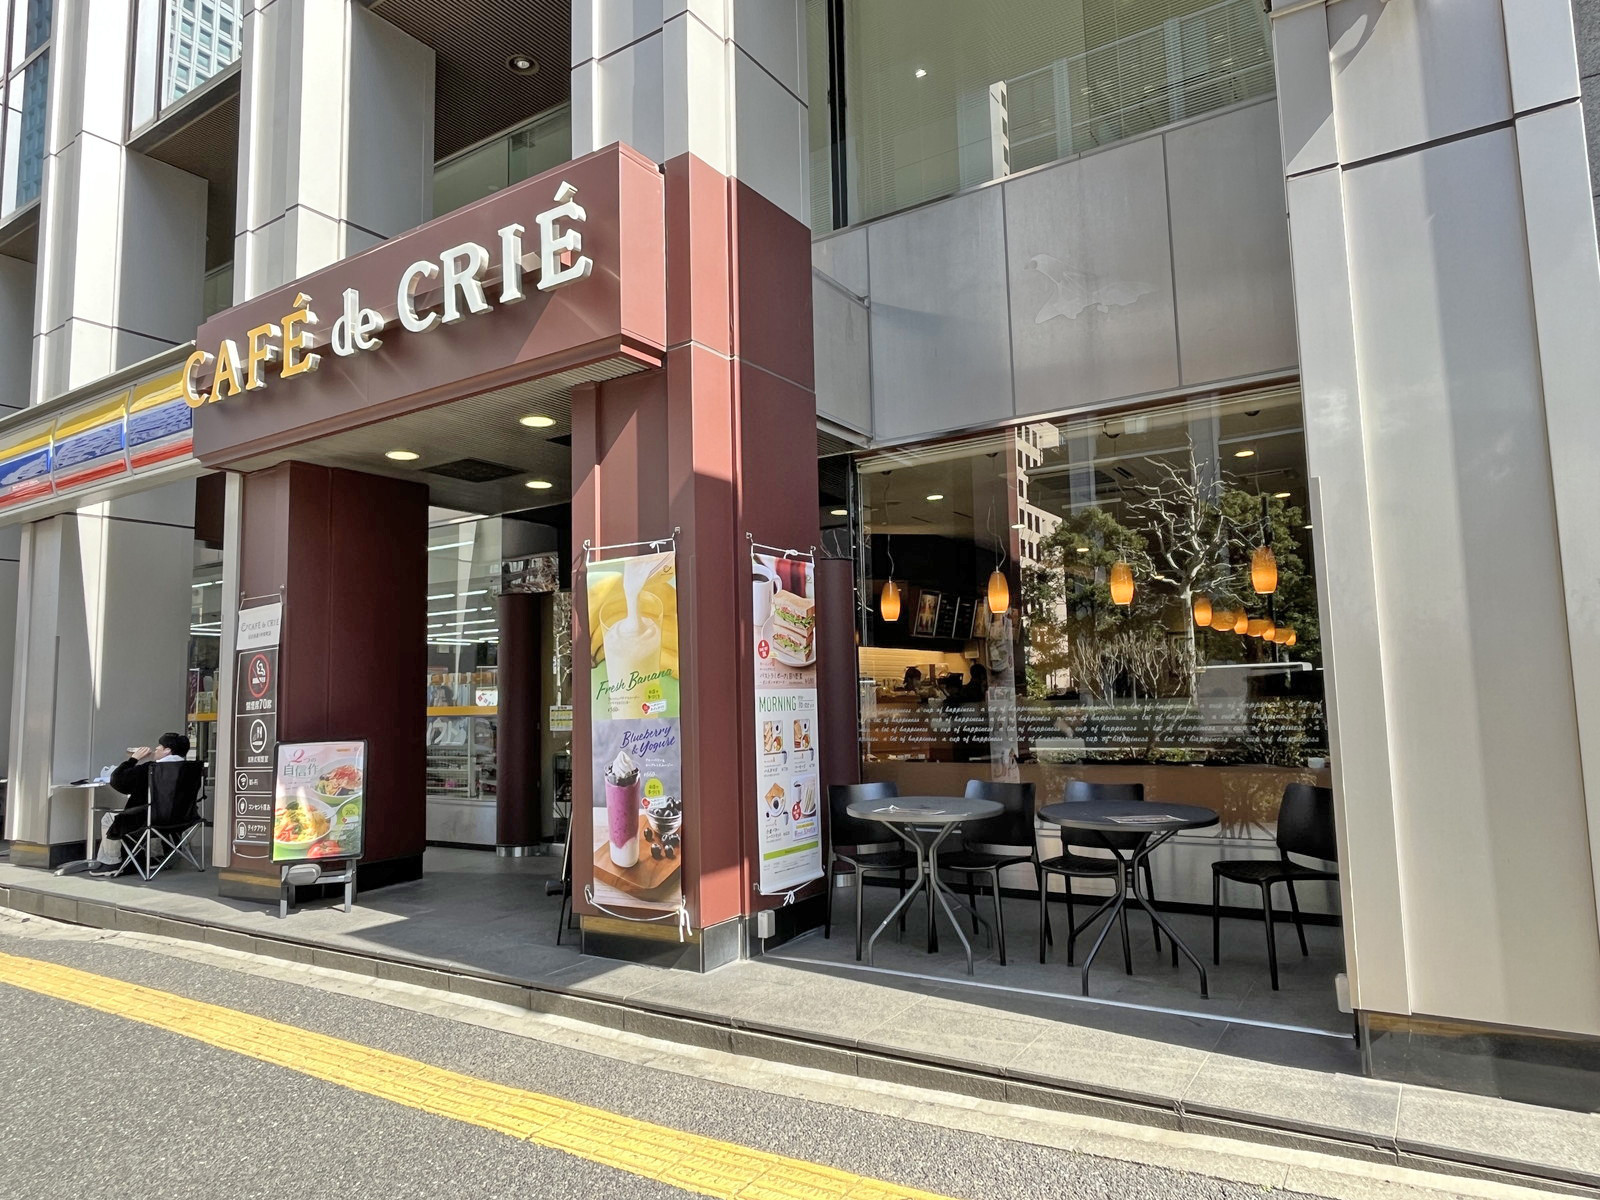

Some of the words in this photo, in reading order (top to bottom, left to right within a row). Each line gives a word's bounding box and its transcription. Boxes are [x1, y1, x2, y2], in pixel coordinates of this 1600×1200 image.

[182, 290, 320, 408] CAFÉ
[331, 287, 385, 357] de
[397, 180, 593, 333] CRIÉ
[596, 679, 625, 700] Fresh
[626, 668, 673, 691] Banana
[759, 696, 796, 712] MORNING
[620, 726, 672, 749] Blueberry
[632, 744, 639, 755] &
[639, 736, 676, 758] Yogurt
[284, 763, 318, 777] 自信作
